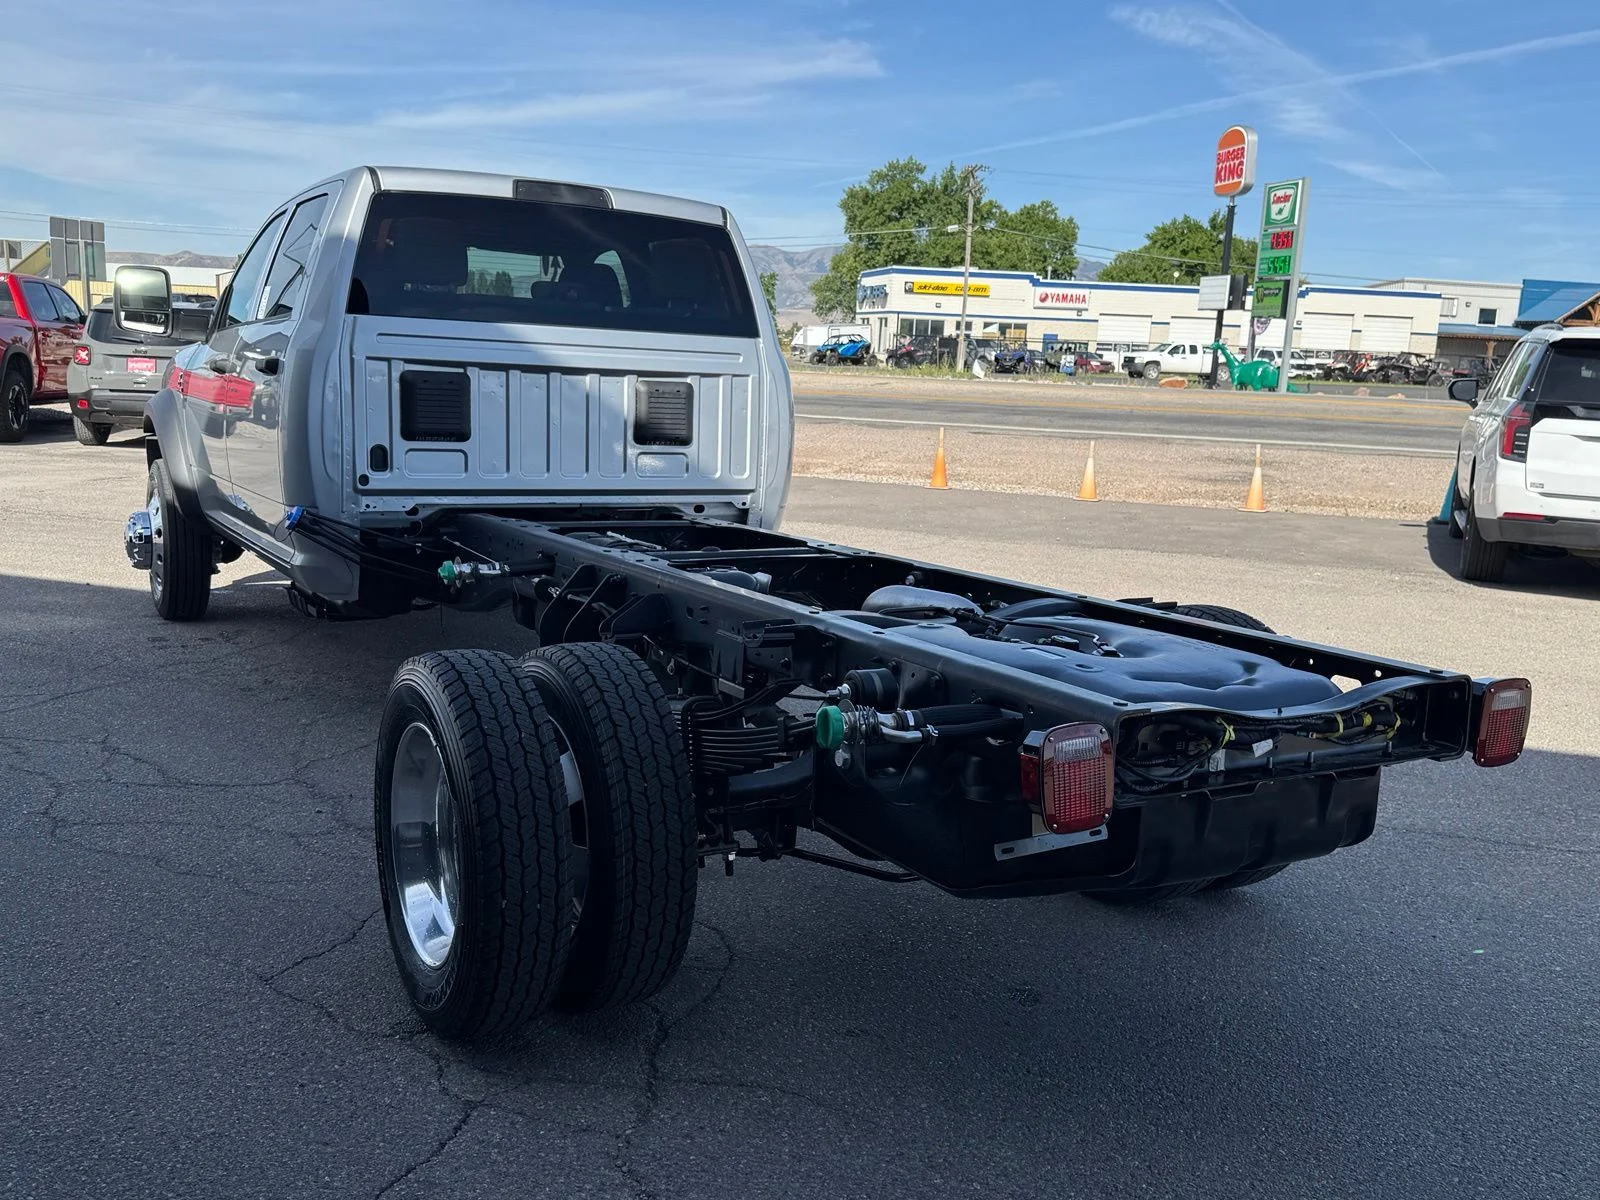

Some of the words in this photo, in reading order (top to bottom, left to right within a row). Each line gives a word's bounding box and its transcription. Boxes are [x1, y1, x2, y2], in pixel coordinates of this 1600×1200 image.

[1216, 146, 1246, 165] BURGER
[1215, 161, 1245, 184] KING
[1271, 192, 1292, 205] Sinclair
[1050, 292, 1087, 304] YAMAHA
